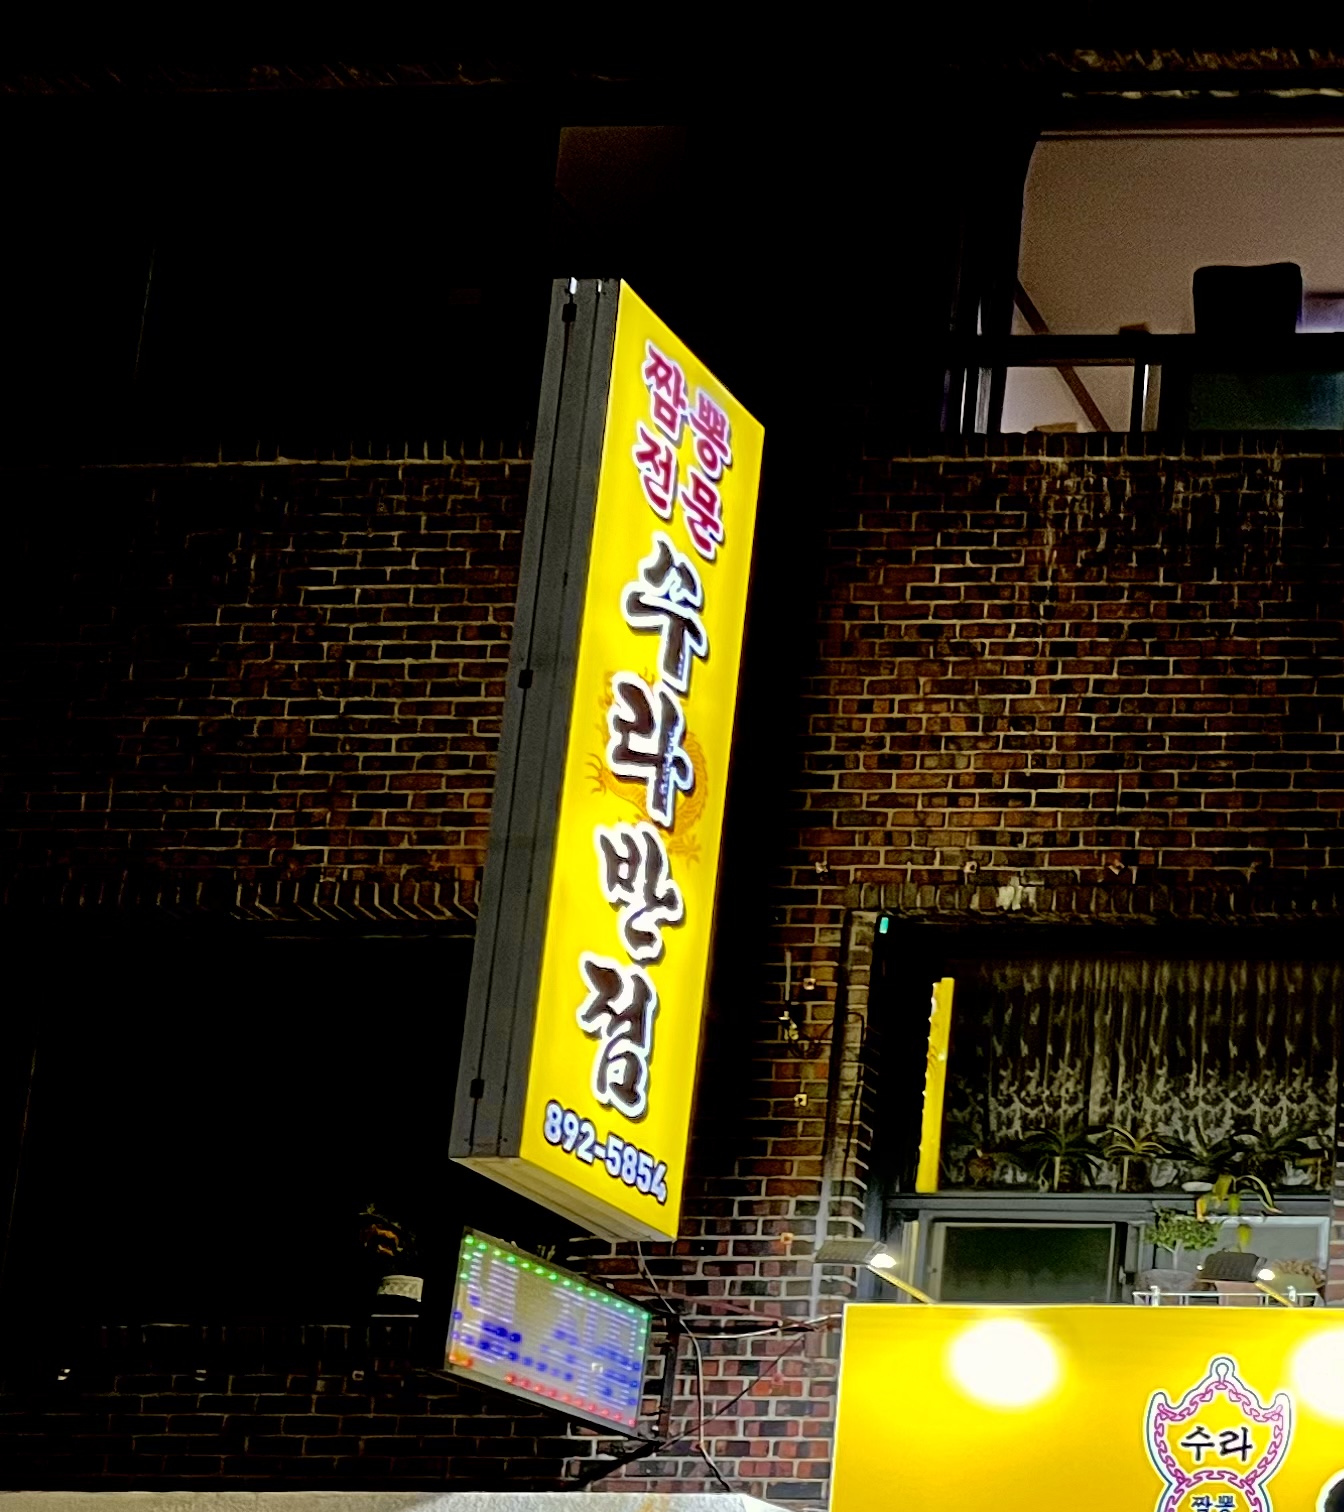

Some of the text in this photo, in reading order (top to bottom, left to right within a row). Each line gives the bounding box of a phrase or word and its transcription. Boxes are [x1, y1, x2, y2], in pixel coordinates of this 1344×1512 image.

[642, 341, 730, 473] 짬뽕
[634, 426, 721, 553] 전문
[582, 539, 704, 1106] 수라반점
[543, 1101, 668, 1203] 892-5854
[1181, 1426, 1253, 1461] 수라
